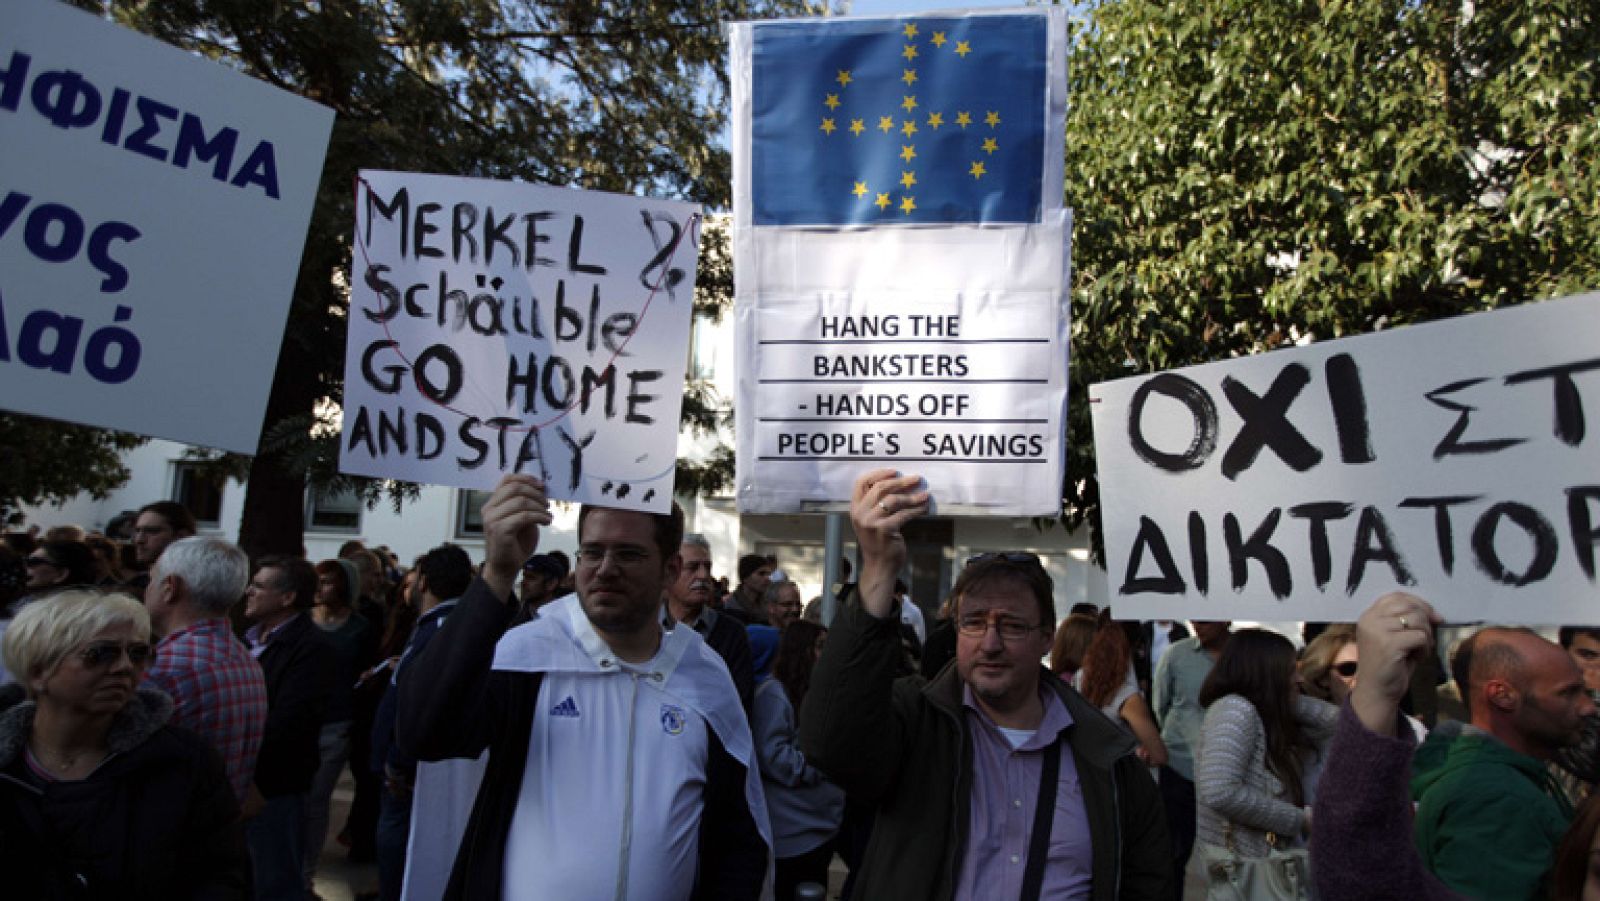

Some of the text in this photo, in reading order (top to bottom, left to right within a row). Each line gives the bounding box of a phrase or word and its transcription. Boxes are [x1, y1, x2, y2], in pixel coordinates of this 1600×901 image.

[362, 184, 608, 277] MERKEL
[0, 288, 142, 385] αό
[362, 264, 638, 356] Schäuble
[820, 314, 960, 339] HANG THE
[361, 339, 666, 425] GO HOME
[813, 354, 970, 378] BANKSTERS
[348, 405, 447, 460] AND
[816, 394, 910, 417] HANDS
[918, 394, 971, 416] OFF
[1127, 352, 1377, 482] ΟΧΙ
[922, 433, 1044, 457] SAVINGS
